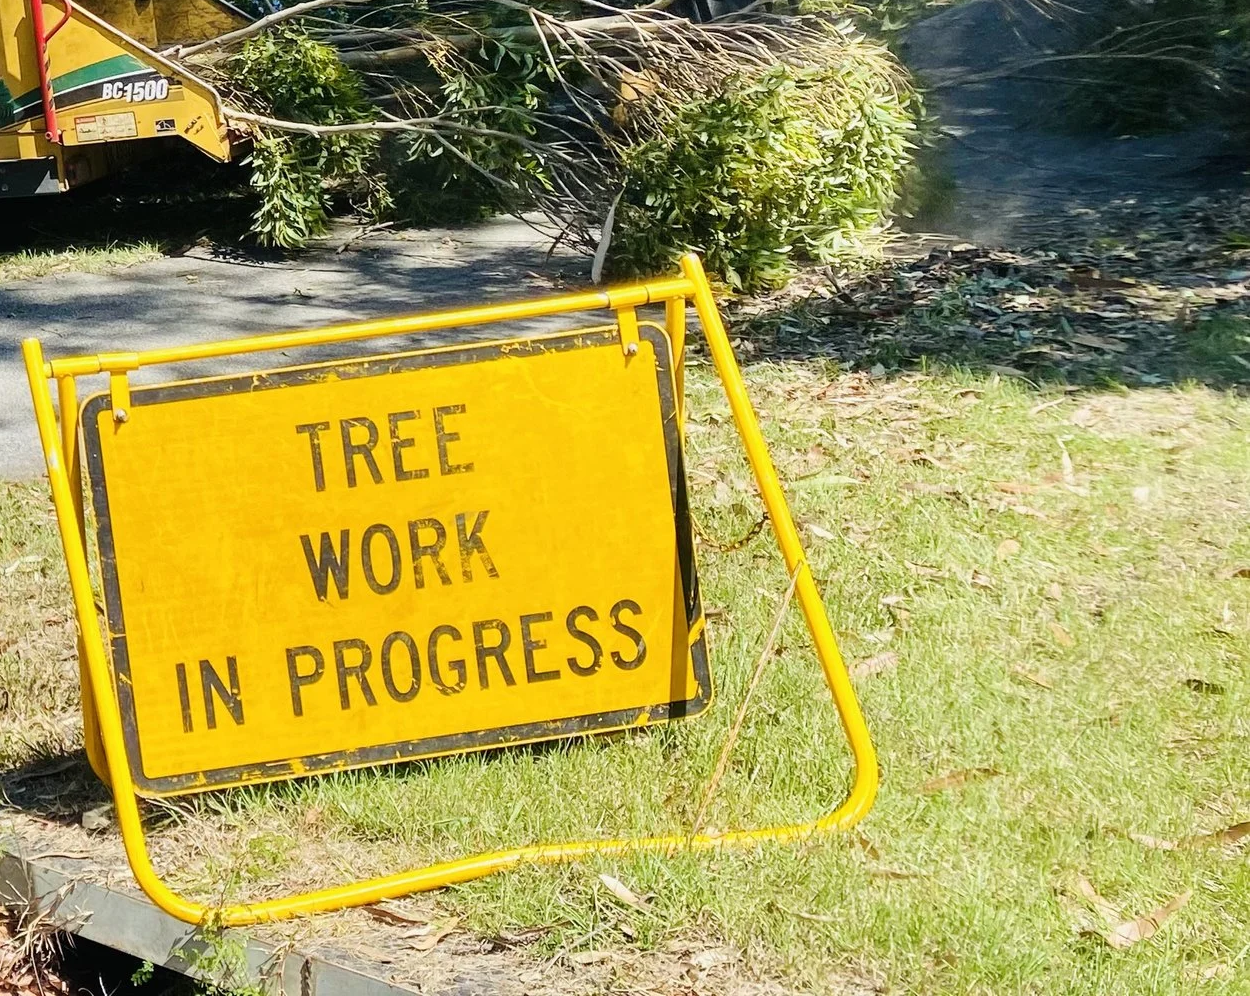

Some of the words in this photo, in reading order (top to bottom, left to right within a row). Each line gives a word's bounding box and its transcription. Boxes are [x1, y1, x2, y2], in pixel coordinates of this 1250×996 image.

[102, 79, 169, 103] BC1500
[295, 404, 475, 493] TREE
[299, 510, 500, 603] WORK
[175, 655, 245, 734] IN
[285, 599, 647, 717] PROGRESS
